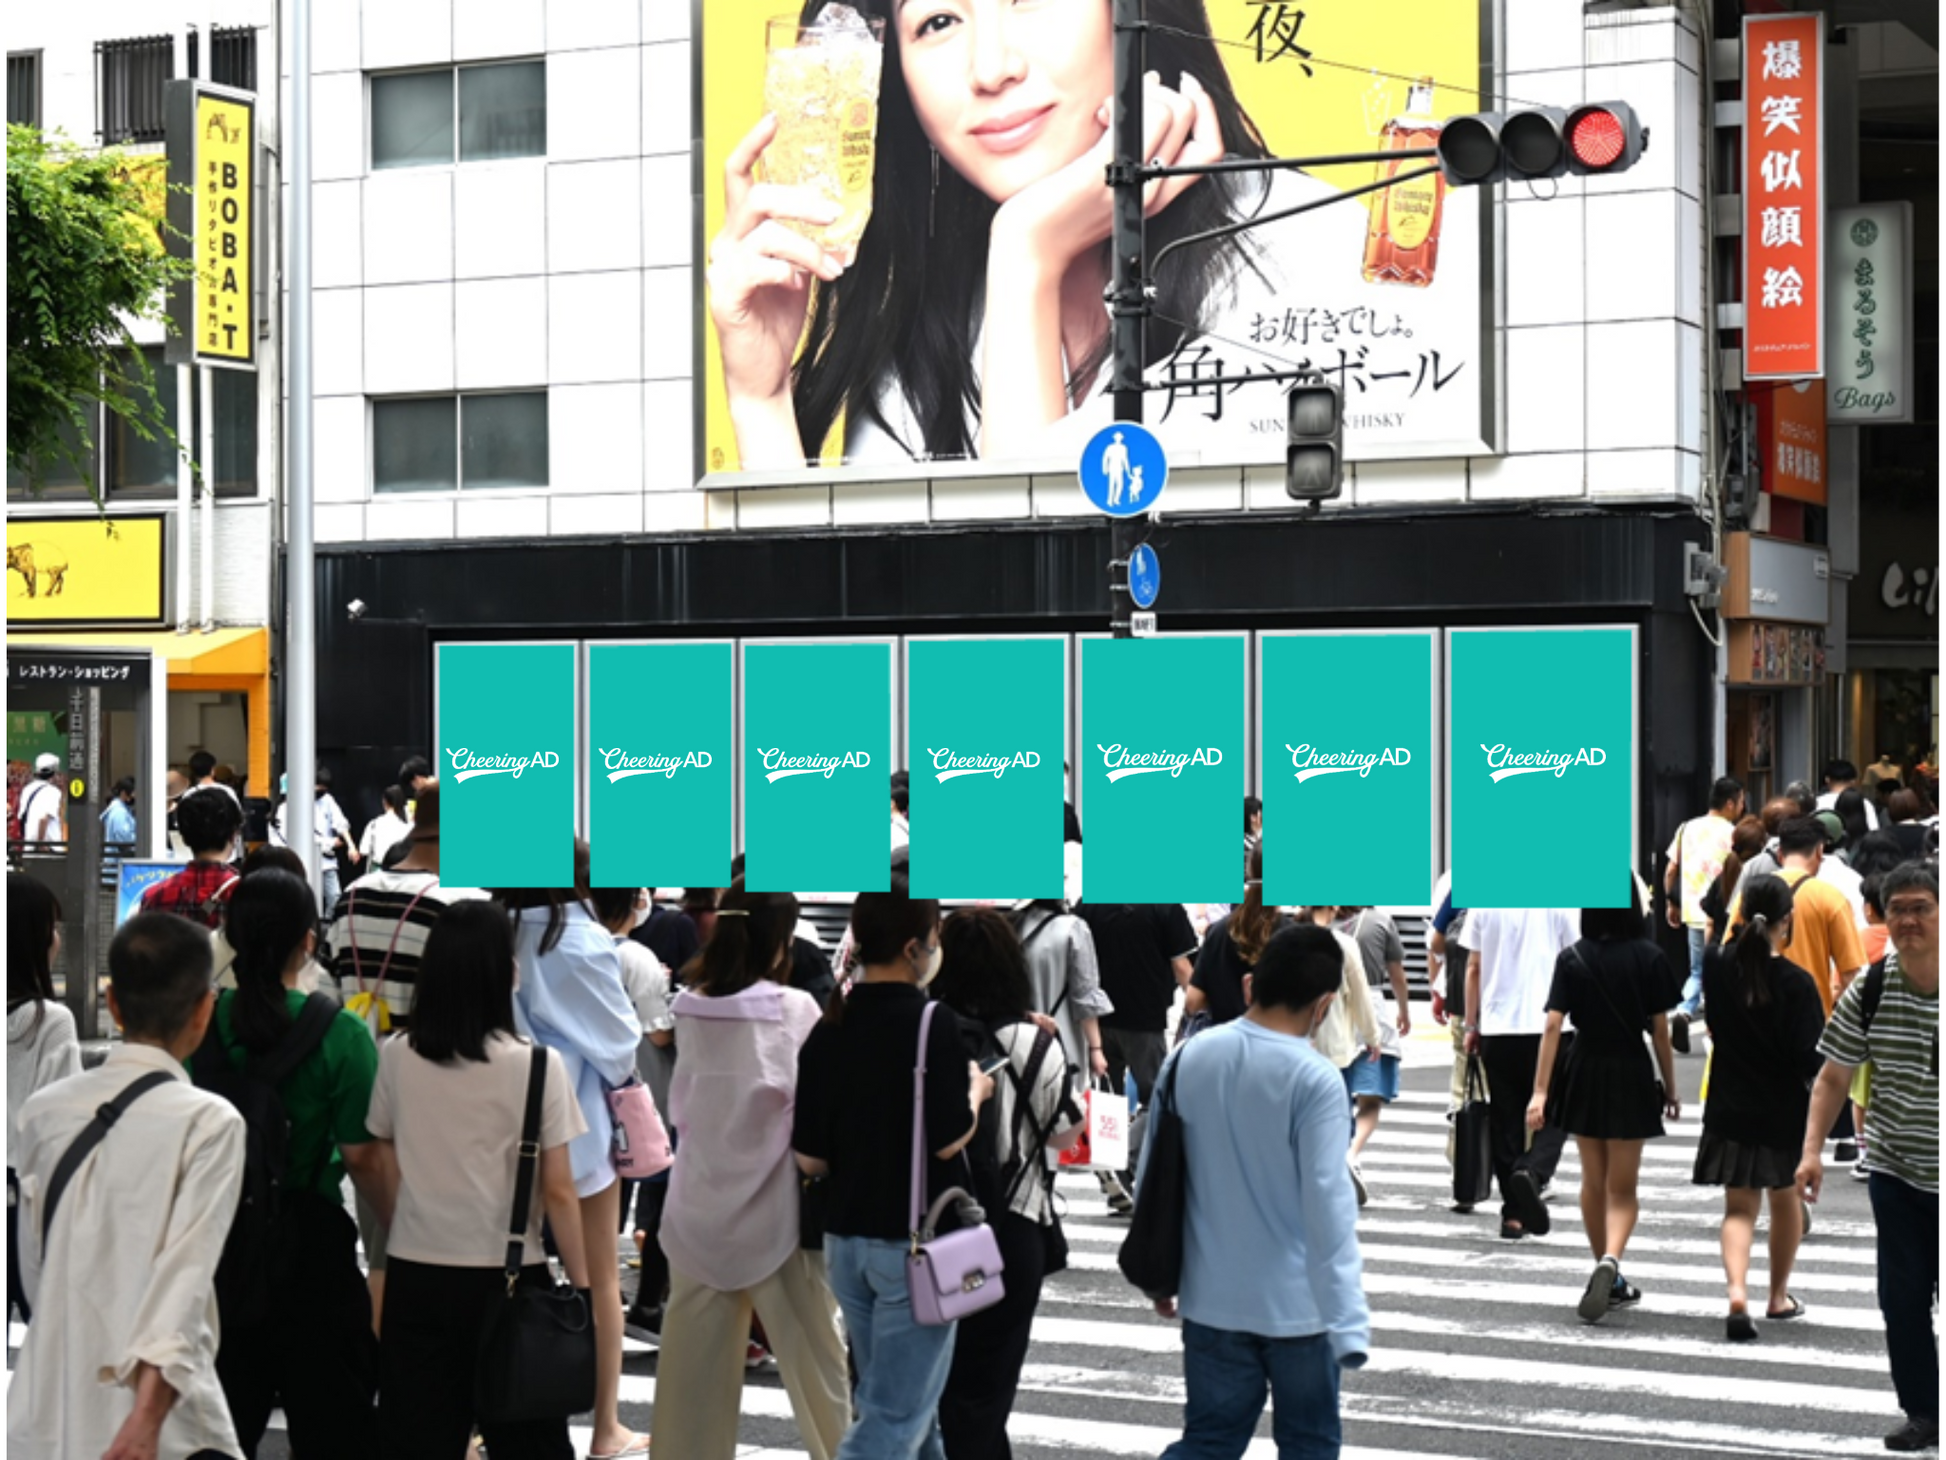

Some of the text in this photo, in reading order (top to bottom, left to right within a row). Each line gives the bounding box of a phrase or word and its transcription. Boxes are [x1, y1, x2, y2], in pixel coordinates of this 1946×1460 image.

[1761, 39, 1803, 309] 爆笑似顔絵
[1249, 305, 1413, 346] お好きでしょ。
[1853, 257, 1877, 380] まるそう
[1834, 387, 1896, 413] Bags
